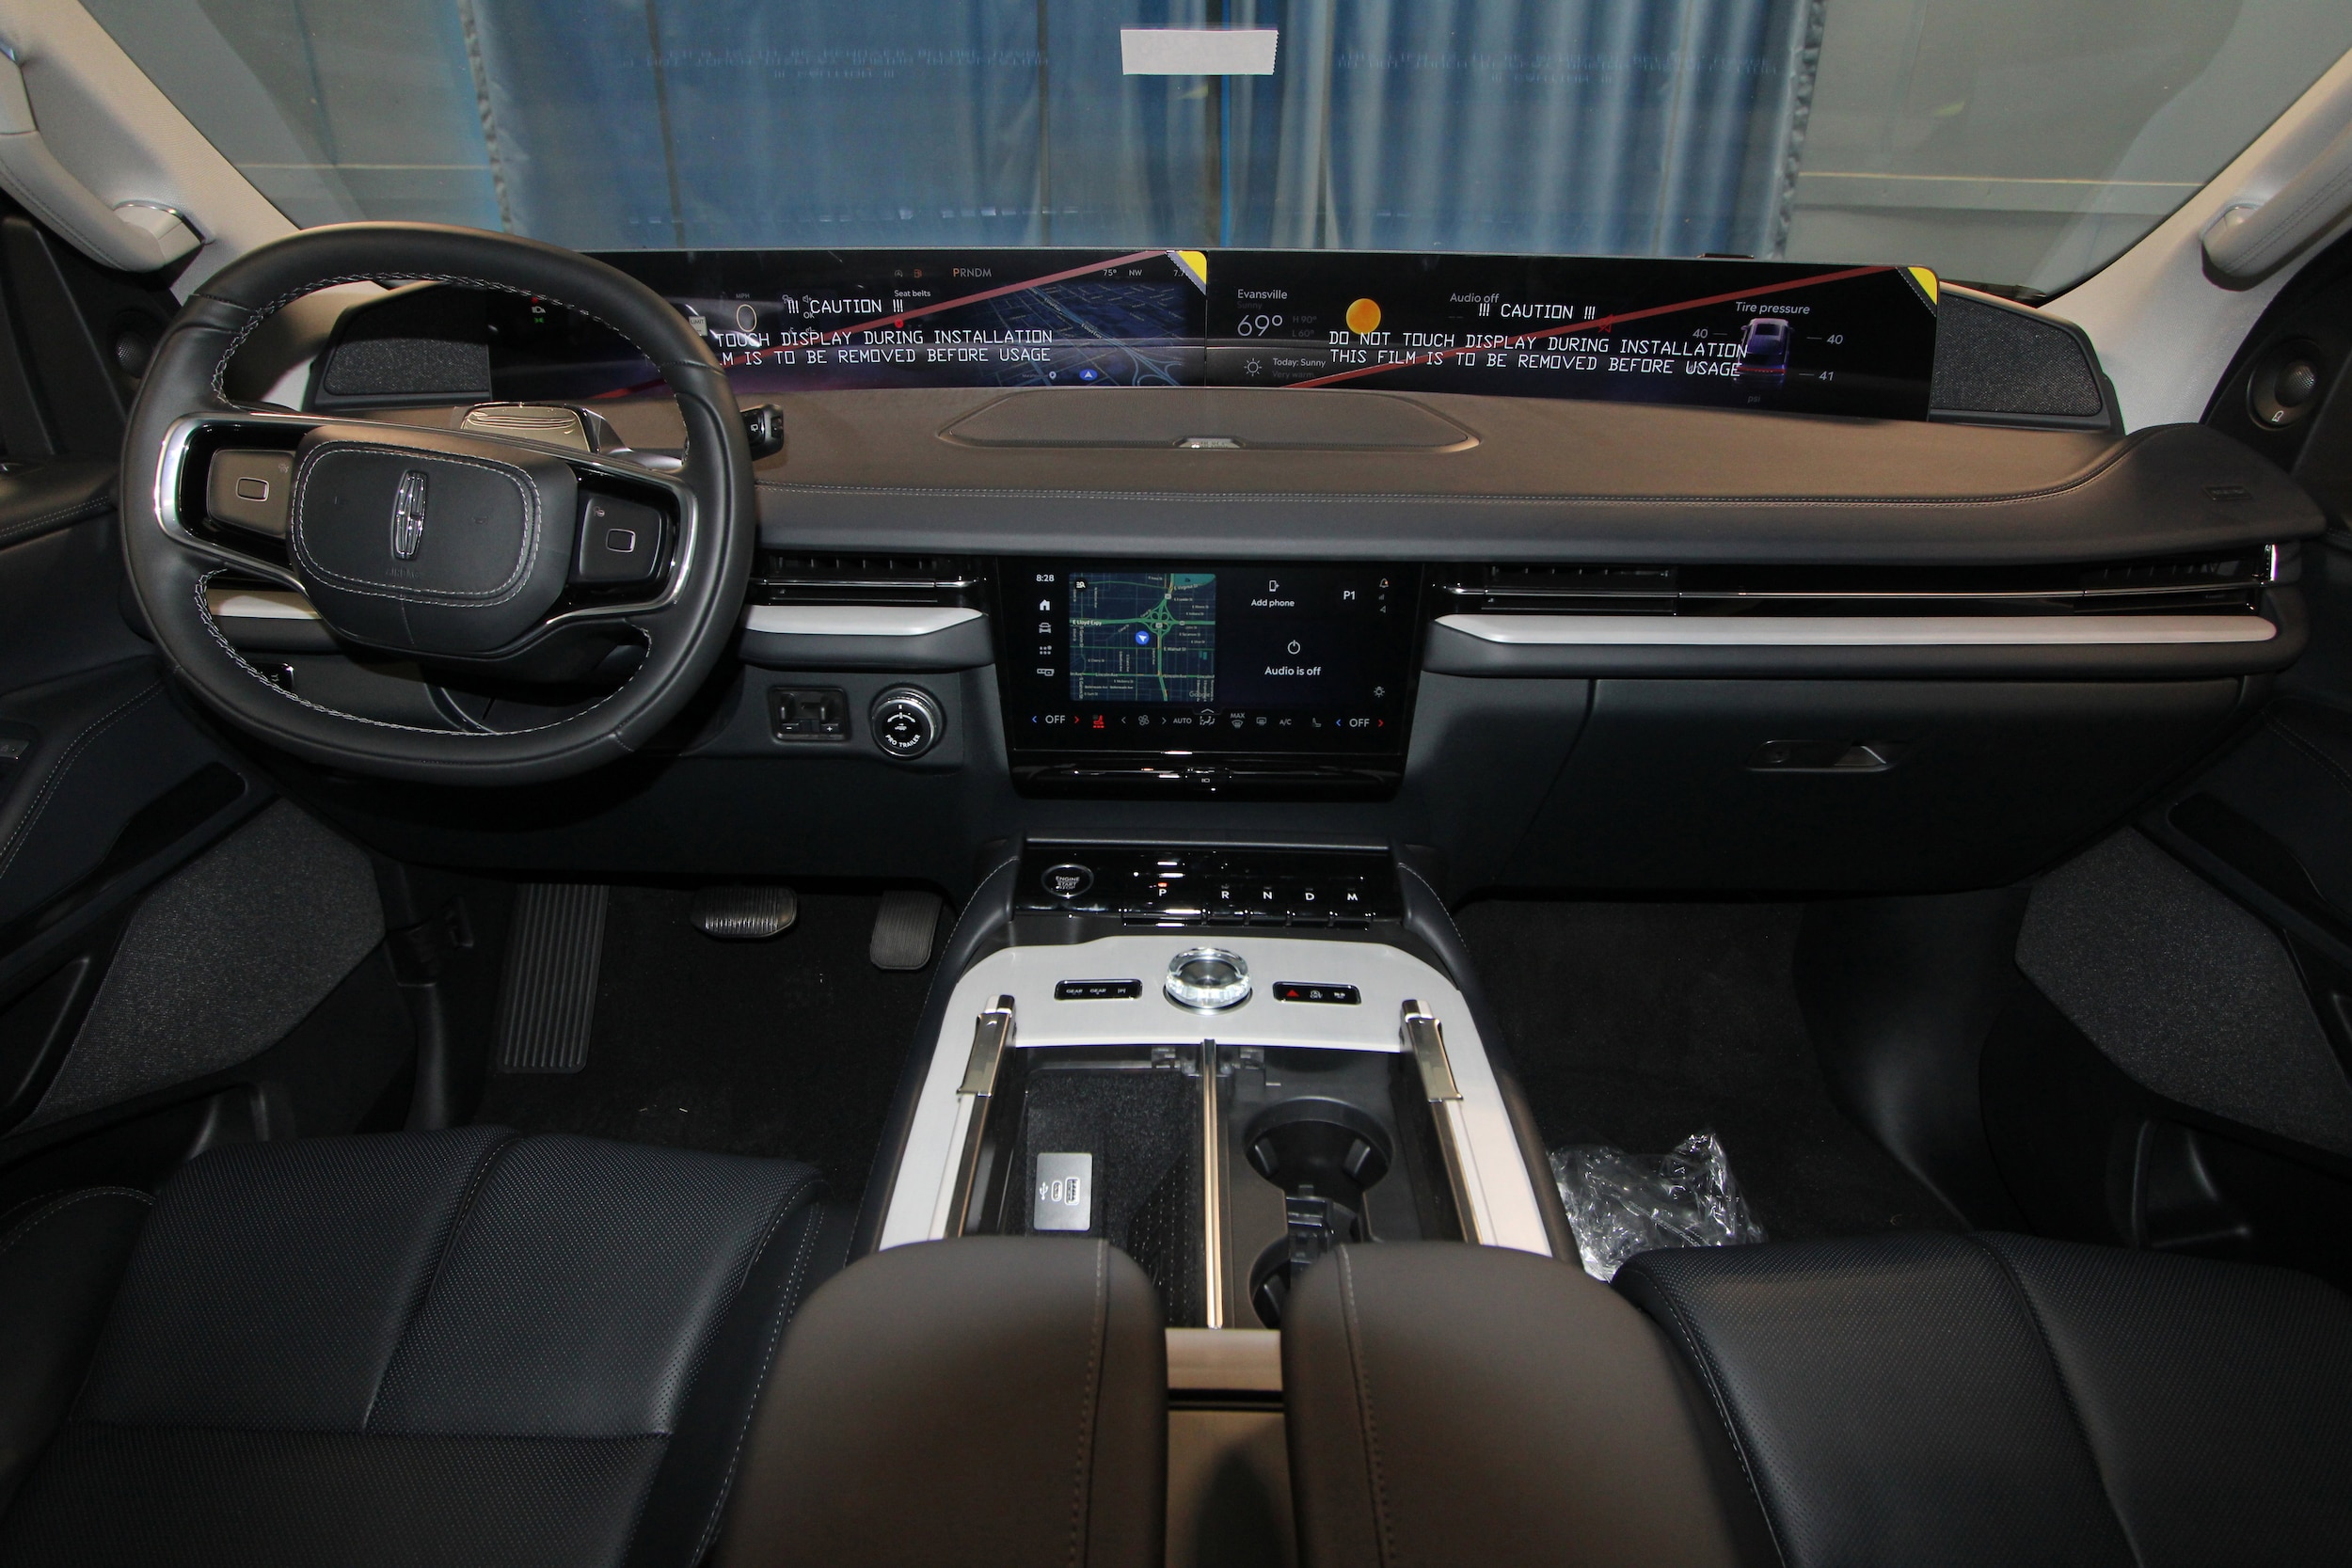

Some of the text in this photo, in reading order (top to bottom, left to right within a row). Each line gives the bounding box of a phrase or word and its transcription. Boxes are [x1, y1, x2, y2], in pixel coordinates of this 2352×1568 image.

[953, 267, 992, 277] PRNDM
[1237, 289, 1288, 299] Evansville
[1449, 293, 1500, 303] Audio off
[810, 299, 882, 314] CAUTION
[1501, 303, 1573, 320] CAUTION
[1736, 302, 1810, 315] Tire pressure
[716, 329, 1053, 347] TOUCH DISPLAY DURING INSTALLATION
[1692, 328, 1708, 339] 40
[1826, 334, 1843, 345] 40
[1328, 331, 1748, 359] DO NOT TOUCH DISPLAY DURING INSTALLATION
[745, 351, 762, 365] IS
[773, 350, 796, 365] TO
[806, 349, 828, 364] BE
[838, 349, 916, 364] REMOVED
[927, 348, 989, 363] BEFORE
[999, 347, 1052, 362] USAGE
[1273, 357, 1327, 368] Today: Sunny
[1330, 349, 1367, 364] THIS
[1377, 350, 1416, 365] FILM
[1426, 351, 1444, 366] IS
[1455, 352, 1475, 367] TO
[1486, 353, 1506, 368] BE
[1518, 354, 1597, 372] REMOVED
[1608, 357, 1675, 374] BEFORE
[1685, 361, 1743, 377] USAGE
[1819, 371, 1835, 381] 41
[1747, 394, 1761, 404] psi
[1036, 574, 1055, 582] 8:28
[1343, 591, 1356, 600] P1
[1269, 598, 1295, 608] phone
[1264, 666, 1322, 676] Audio is off
[1045, 715, 1066, 724] OFF
[1349, 719, 1370, 727] OFF
[885, 734, 921, 748] PRO TRAILER
[1221, 891, 1230, 899] R
[1263, 892, 1272, 900] N
[1305, 893, 1314, 901] D
